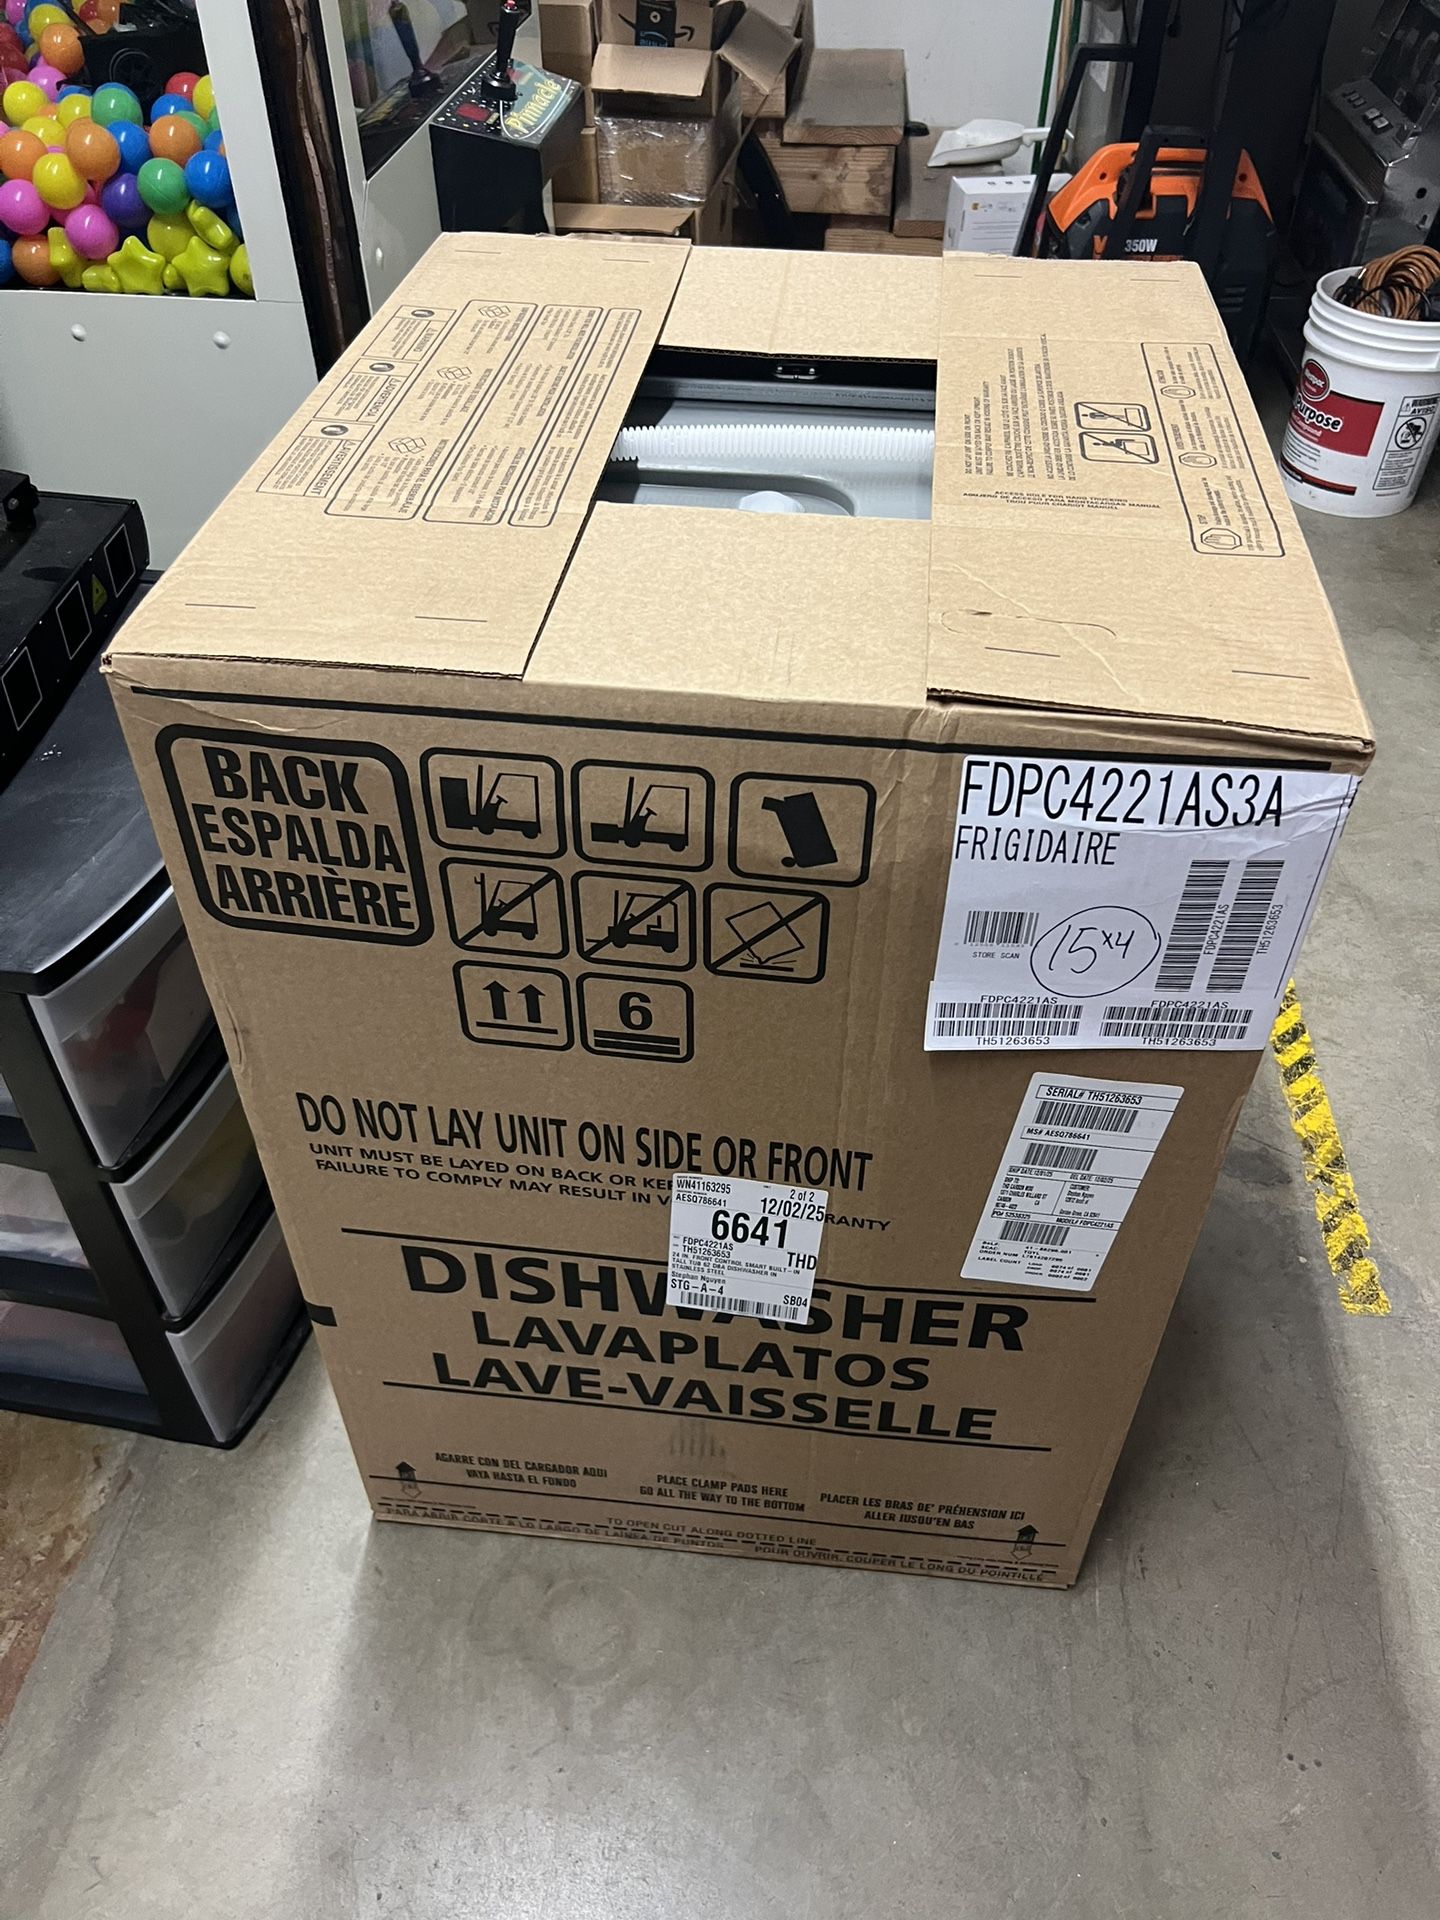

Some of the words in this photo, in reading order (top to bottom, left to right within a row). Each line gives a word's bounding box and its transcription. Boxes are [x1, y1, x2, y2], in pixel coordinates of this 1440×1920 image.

[505, 79, 562, 133] Pinnacle
[1125, 239, 1158, 253] 350W
[363, 383, 398, 417] ADVERTENCIA
[306, 446, 353, 495] AVERTISSEMENT
[202, 746, 368, 814] BACK
[961, 760, 1283, 828] FDPC4221AS3A
[191, 803, 406, 873] ESPALDA
[955, 825, 1120, 866] FRIGIDAIRE
[215, 864, 415, 930] ARRIÈRE
[1203, 904, 1229, 956] FDPC4221AS
[1257, 904, 1284, 955] TH51263653
[972, 951, 996, 959] STORE
[1001, 952, 1020, 960] SCAN
[618, 991, 654, 1031] 6
[980, 994, 1058, 1005] FDPC4221AS
[1150, 1000, 1229, 1009] FDPC4221AS
[976, 1036, 1050, 1046] TH51263653
[1142, 1037, 1217, 1047] TH51263653
[1044, 1087, 1085, 1099] SERIAL#
[1085, 1091, 1143, 1105] TH51263653
[296, 1092, 346, 1136] DO
[353, 1098, 419, 1142] NOT
[428, 1106, 484, 1150] LAY
[495, 1112, 568, 1157] UNIT
[578, 1120, 626, 1165] ON
[636, 1126, 702, 1172] SIDE
[712, 1135, 757, 1176] OR
[768, 1140, 874, 1192] FRONT
[1025, 1127, 1044, 1136] MS#
[308, 1142, 356, 1159] UNIT
[362, 1147, 416, 1164] MUST
[420, 1154, 444, 1166] BE
[448, 1156, 510, 1174] LAYED
[515, 1162, 544, 1176] ON
[551, 1166, 603, 1183] BACK
[608, 1173, 638, 1186] OR
[316, 1159, 390, 1178] FAILURE
[394, 1165, 421, 1178] TO
[426, 1168, 504, 1190] COMPLY
[509, 1178, 553, 1194] MAY
[558, 1182, 627, 1203] RESULT
[632, 1190, 652, 1204] IN
[676, 1177, 731, 1195] WN41163295
[675, 1193, 726, 1207] AESQ786641
[789, 1189, 795, 1200] 2
[797, 1190, 806, 1201] of
[808, 1191, 815, 1202] 2
[759, 1197, 825, 1221] 12/02/25
[711, 1208, 788, 1249] 6641
[824, 1214, 891, 1231] RANTY
[682, 1236, 733, 1250] FDPC4221AS
[682, 1244, 731, 1258] TH51263653
[671, 1263, 704, 1272] STAINLESS
[692, 1254, 712, 1262] FRONT
[714, 1257, 742, 1266] CONTROL
[744, 1261, 767, 1270] SMART
[727, 1265, 768, 1275] DISHWASHER
[785, 1251, 817, 1270] THD
[671, 1270, 698, 1281] Stephan
[700, 1274, 726, 1285] Nguyen
[401, 1245, 1030, 1352] DISHWSHER
[782, 1295, 808, 1307] SB04
[471, 1311, 930, 1391] LAVAPLATOS
[432, 1352, 998, 1441] LAVE-VAISSELLE
[435, 1452, 475, 1466] AGARRE
[478, 1457, 499, 1468] CON
[502, 1458, 522, 1470] DEL
[525, 1461, 580, 1476] CARGADOR
[583, 1467, 608, 1478] AQUI
[466, 1468, 490, 1480] VAYA
[493, 1471, 526, 1484] HASTA
[528, 1474, 540, 1485] EL
[542, 1476, 577, 1488] FONDO
[656, 1474, 689, 1486] PLACE
[692, 1477, 728, 1491] CLAMP
[731, 1482, 758, 1494] PADS
[761, 1485, 788, 1498] HERE
[639, 1486, 654, 1496] GO
[657, 1487, 676, 1498] ALL
[678, 1489, 698, 1500] THE
[700, 1492, 722, 1503] WAY
[725, 1494, 738, 1504] TO
[741, 1496, 761, 1508] THE
[763, 1498, 805, 1512] BOTTOM
[820, 1492, 859, 1506] PLACER
[862, 1496, 881, 1508] LES
[884, 1498, 913, 1511] BRAS
[938, 1503, 1007, 1519] PRÉHENSION
[1010, 1509, 1025, 1520] ICI
[606, 1517, 623, 1525] TO
[626, 1520, 659, 1529] OPEN
[662, 1523, 687, 1532] CUT
[691, 1526, 732, 1538] ALONG
[736, 1532, 785, 1542] DOTTED
[789, 1537, 816, 1546] LINE
[863, 1510, 897, 1523] ALLER
[899, 1513, 951, 1528] JUSQU'EN
[953, 1518, 975, 1529] BAS
[754, 1545, 789, 1556] POUR
[846, 1555, 897, 1566] COUPER
[900, 1560, 915, 1568] LE
[920, 1562, 954, 1573] LONG
[958, 1566, 976, 1576] DU
